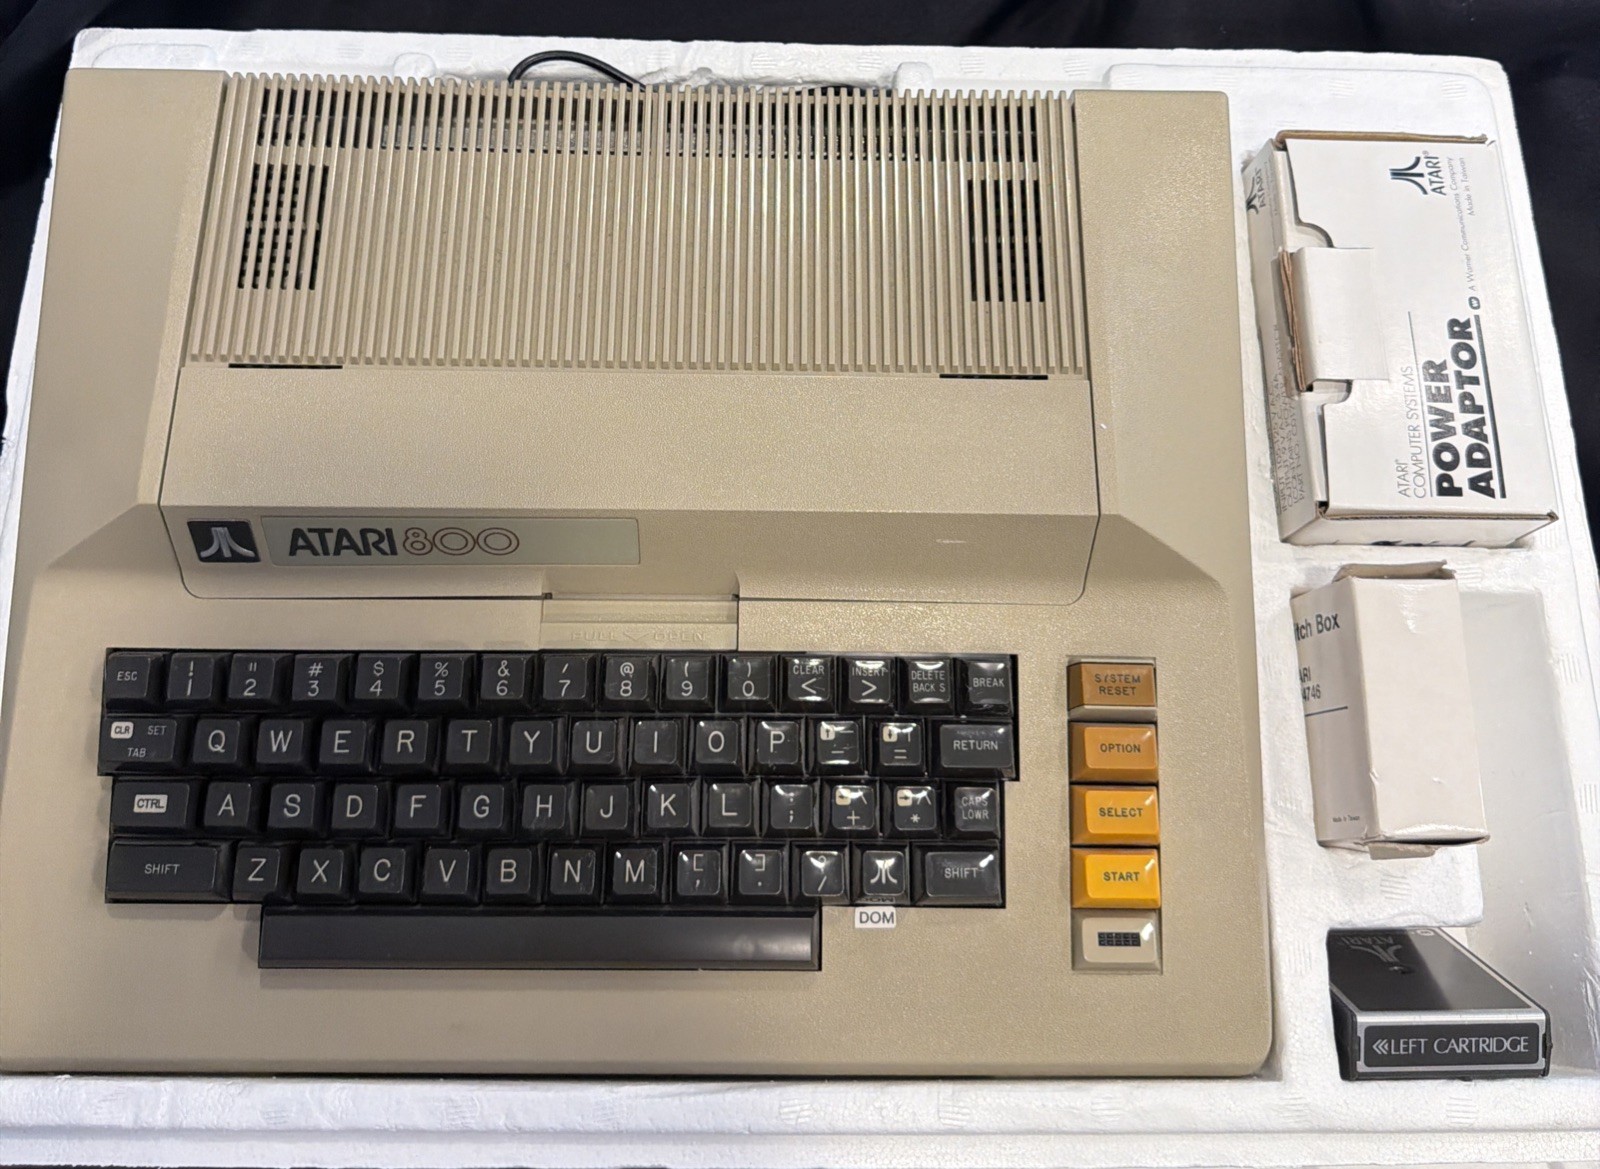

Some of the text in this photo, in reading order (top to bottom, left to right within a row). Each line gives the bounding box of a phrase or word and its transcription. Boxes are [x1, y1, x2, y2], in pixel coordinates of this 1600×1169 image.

[1446, 156, 1458, 191] Company
[1459, 157, 1468, 184] Taiwan
[1465, 194, 1475, 216] Made
[1454, 193, 1470, 251] Communications
[1448, 317, 1496, 499] ADAPTOR
[1400, 365, 1427, 499] COMPUTER SYSTEMS
[1422, 359, 1464, 498] POWER
[289, 526, 520, 557] ATARI 800
[1315, 612, 1340, 634] Box
[117, 671, 137, 681] ESC
[309, 662, 324, 676] #
[374, 661, 384, 676] $
[435, 662, 450, 676] %
[497, 660, 510, 676] &
[620, 662, 634, 677] @
[792, 665, 824, 676] CLEAR
[852, 666, 886, 677] INSERT
[912, 670, 946, 680] DELETE
[243, 680, 256, 697] 2
[308, 680, 320, 697] 3
[369, 681, 384, 697] 4
[434, 682, 446, 697] 5
[496, 680, 508, 696] 6
[558, 680, 571, 696] 7
[620, 680, 632, 697] 8
[681, 680, 693, 696] 9
[912, 682, 946, 693] BACK S
[972, 678, 1005, 688] BREAK
[1099, 686, 1137, 696] RESET
[114, 726, 130, 735] CLR
[148, 726, 167, 736] SET
[208, 730, 226, 752] Q
[270, 730, 293, 752] W
[462, 730, 478, 752] T
[708, 730, 725, 752] O
[334, 730, 352, 754] E
[397, 730, 414, 753] R
[524, 730, 540, 754] Y
[586, 730, 602, 753] U
[770, 730, 786, 753] P
[953, 740, 999, 750] RETURN
[1100, 744, 1142, 754] OPTION
[127, 748, 146, 758] TAB
[136, 798, 165, 810] CTRL
[218, 794, 236, 817] A
[283, 794, 301, 818] S
[346, 795, 363, 818] D
[410, 795, 427, 818] F
[472, 794, 490, 818] G
[536, 795, 552, 818] H
[600, 795, 614, 818] J
[660, 794, 677, 816] K
[721, 794, 738, 816] L
[961, 796, 988, 807] CAPS
[962, 810, 990, 820] LOWR
[1098, 808, 1143, 818] SELECT
[144, 864, 180, 875] SHIFT
[248, 858, 266, 882] Z
[310, 860, 330, 883] X
[374, 860, 391, 882] C
[439, 860, 456, 883] V
[500, 859, 517, 883] B
[564, 859, 580, 883] N
[625, 859, 644, 883] M
[944, 868, 978, 879] SHIFT
[1104, 872, 1140, 882] START
[858, 912, 895, 925] DOM
[1390, 1036, 1529, 1056] LEFT CARTRIDGE
